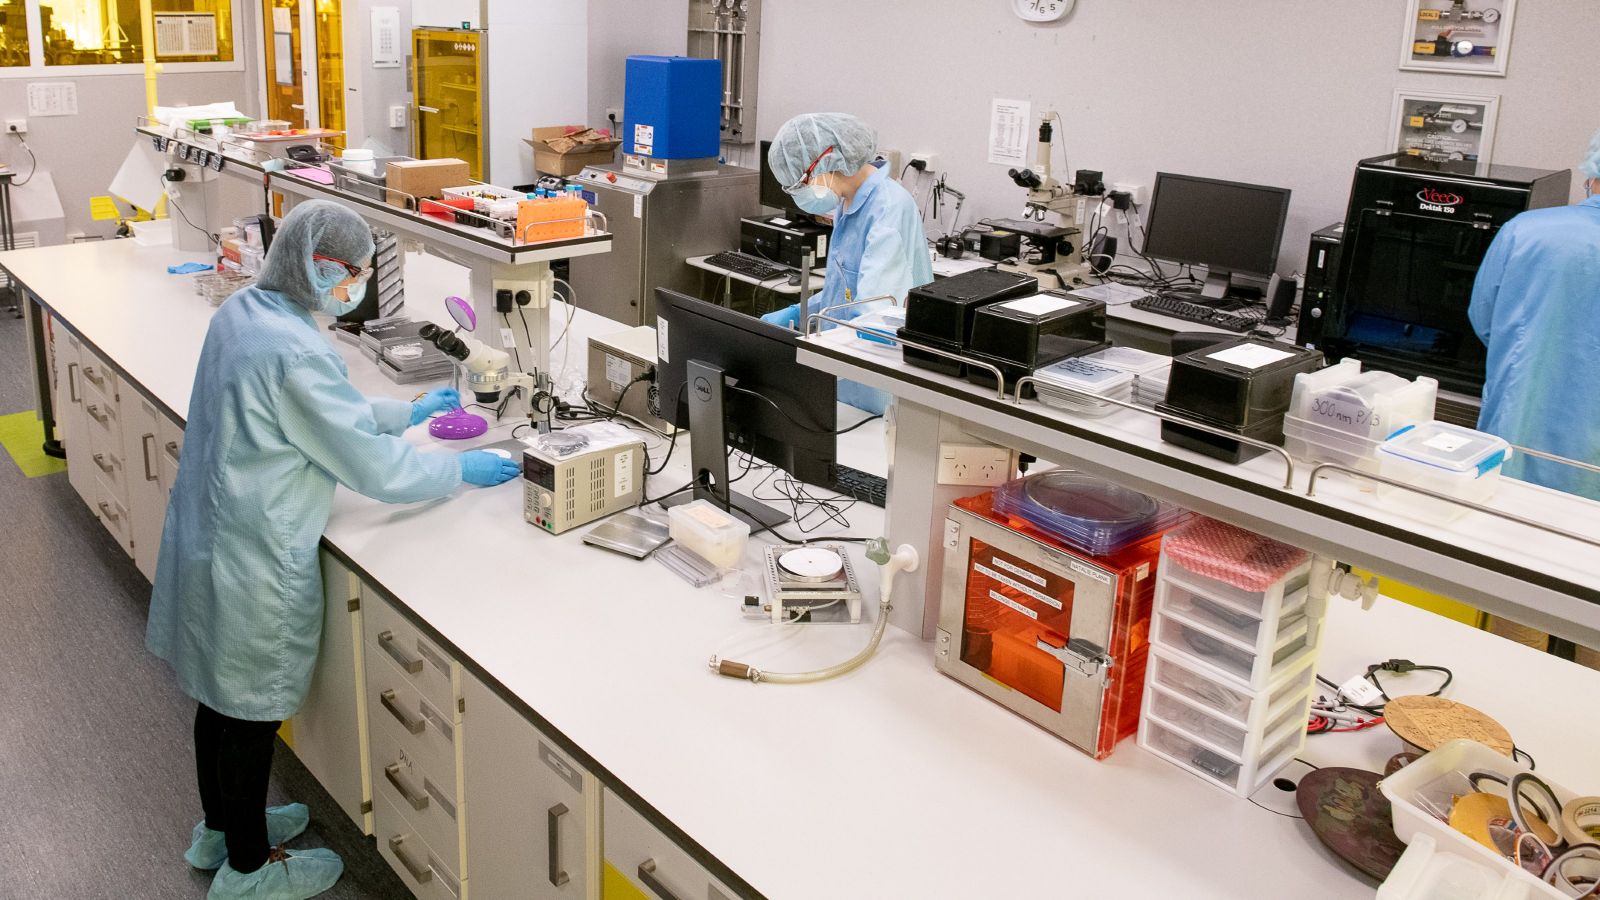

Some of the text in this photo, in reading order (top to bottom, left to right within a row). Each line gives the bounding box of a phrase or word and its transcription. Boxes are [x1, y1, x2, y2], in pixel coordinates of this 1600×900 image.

[1419, 203, 1455, 214] Dektak 150
[1013, 566, 1033, 580] GENERAL
[1072, 562, 1091, 575] NATALIE
[1012, 580, 1032, 594] WITHOUT
[1032, 589, 1060, 607] PERMISSION
[1017, 603, 1036, 617] NATALIE
